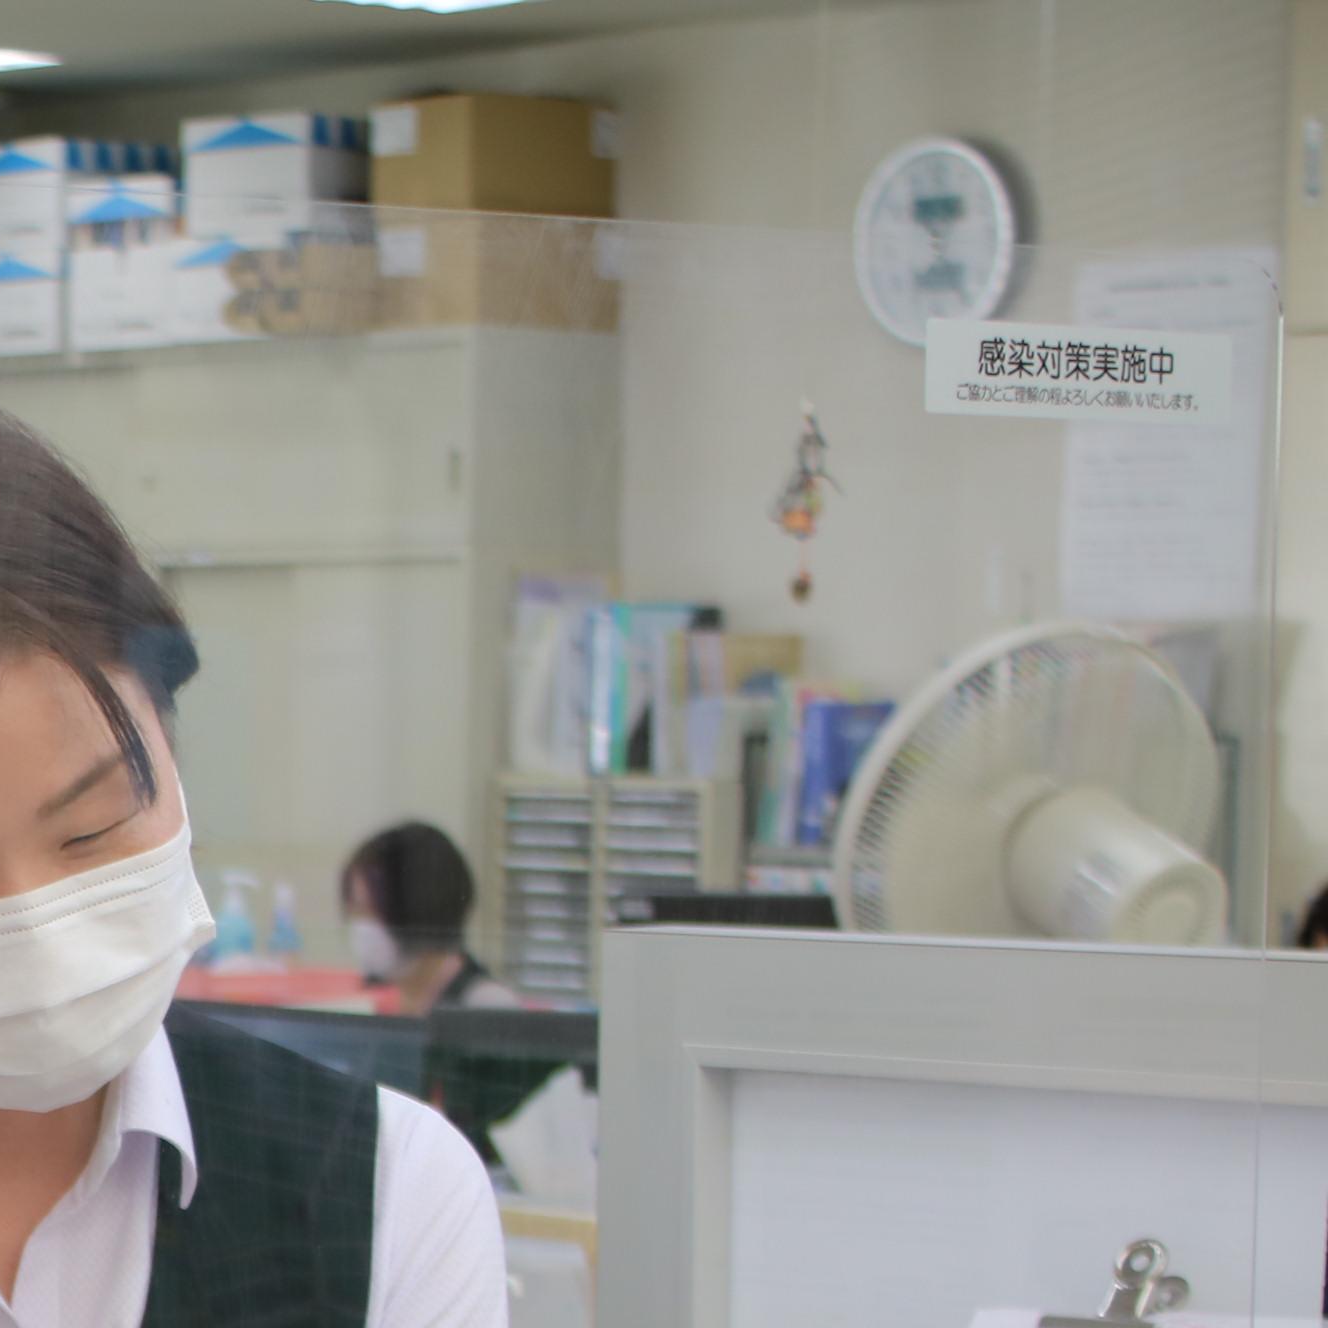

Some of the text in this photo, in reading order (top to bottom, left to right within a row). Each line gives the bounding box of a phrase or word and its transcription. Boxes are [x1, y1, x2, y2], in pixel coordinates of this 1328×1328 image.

[978, 337, 1174, 385] 感染対策実施中
